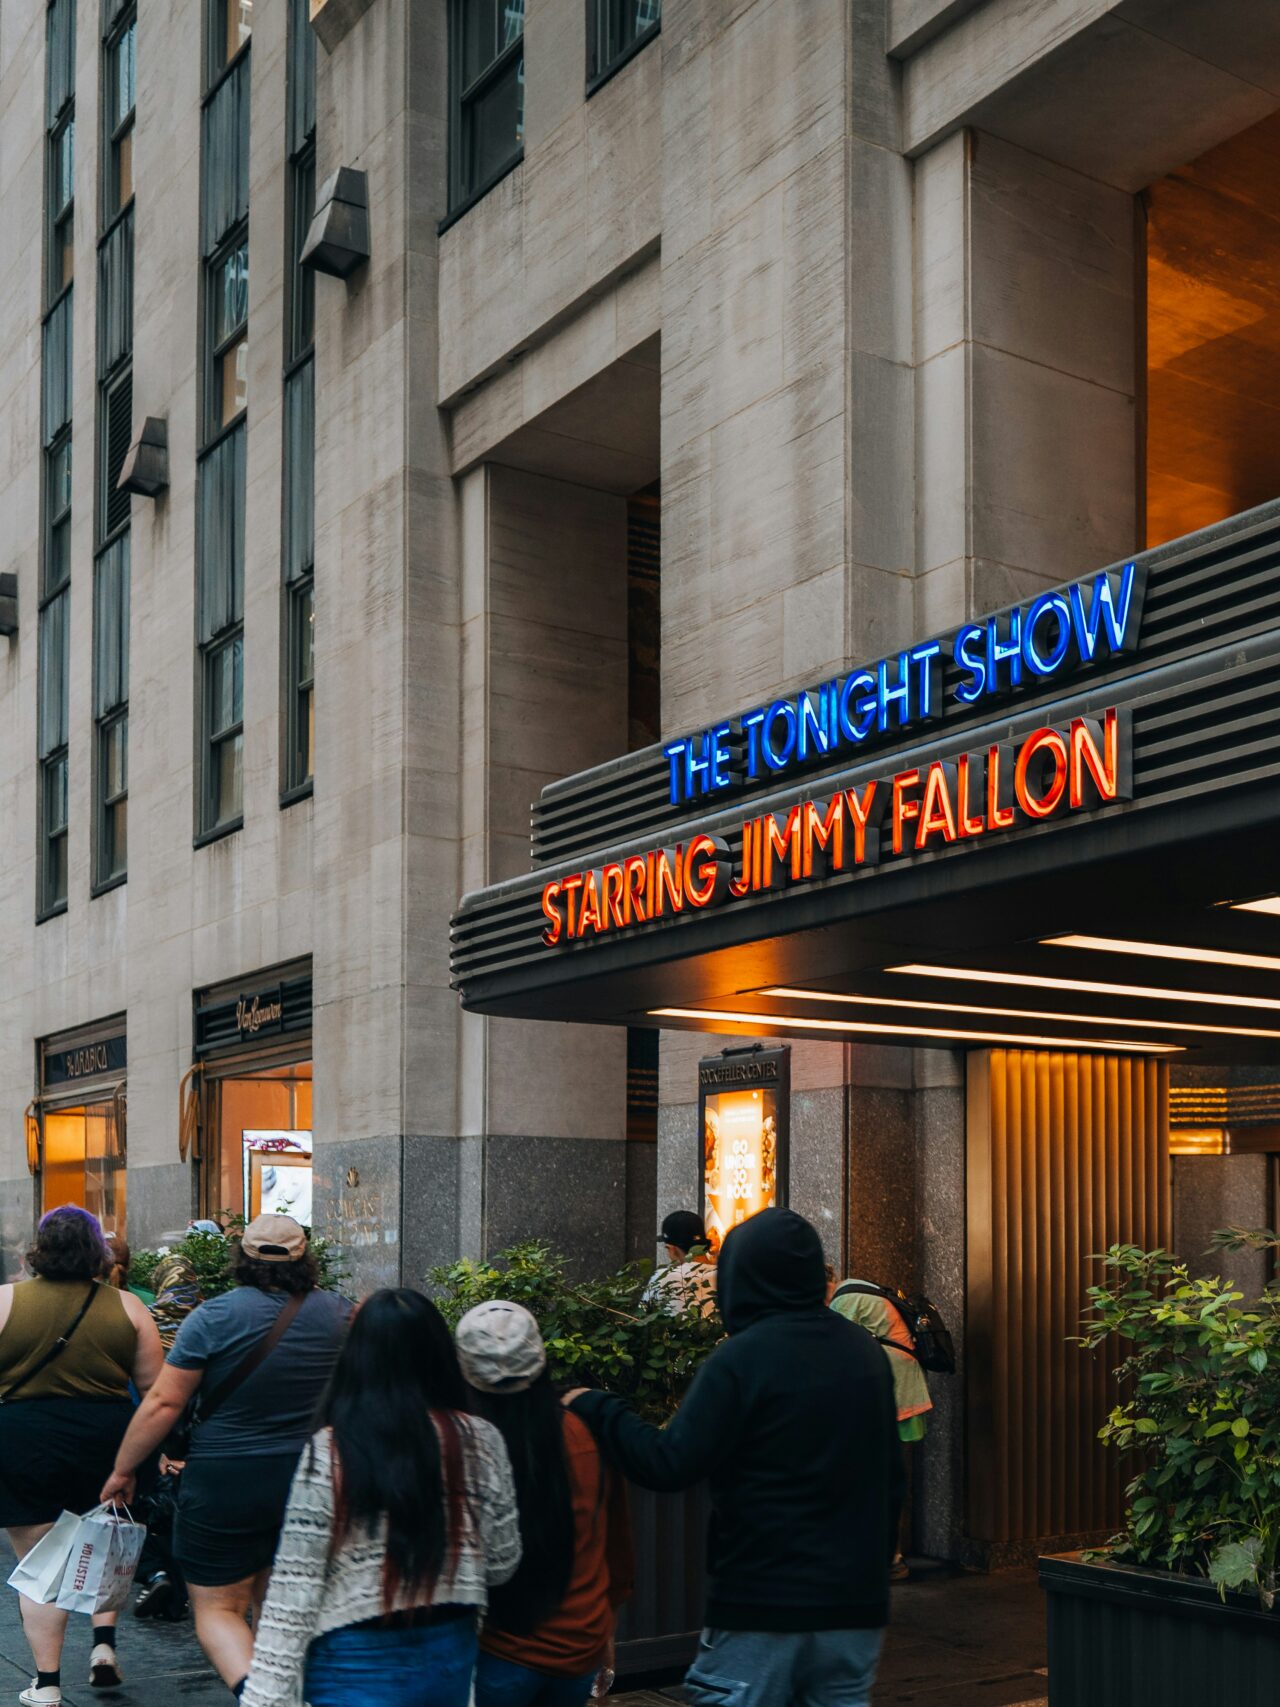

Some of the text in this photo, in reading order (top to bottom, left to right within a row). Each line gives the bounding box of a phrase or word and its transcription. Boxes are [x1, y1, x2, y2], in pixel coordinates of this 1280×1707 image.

[664, 561, 1137, 805] THE TONIGHT SHOW
[541, 706, 1118, 946] STARRING JIMMY FALLON
[700, 1060, 776, 1085] ROCKEFELLER CENTER
[73, 1543, 94, 1592] HOLLISTER
